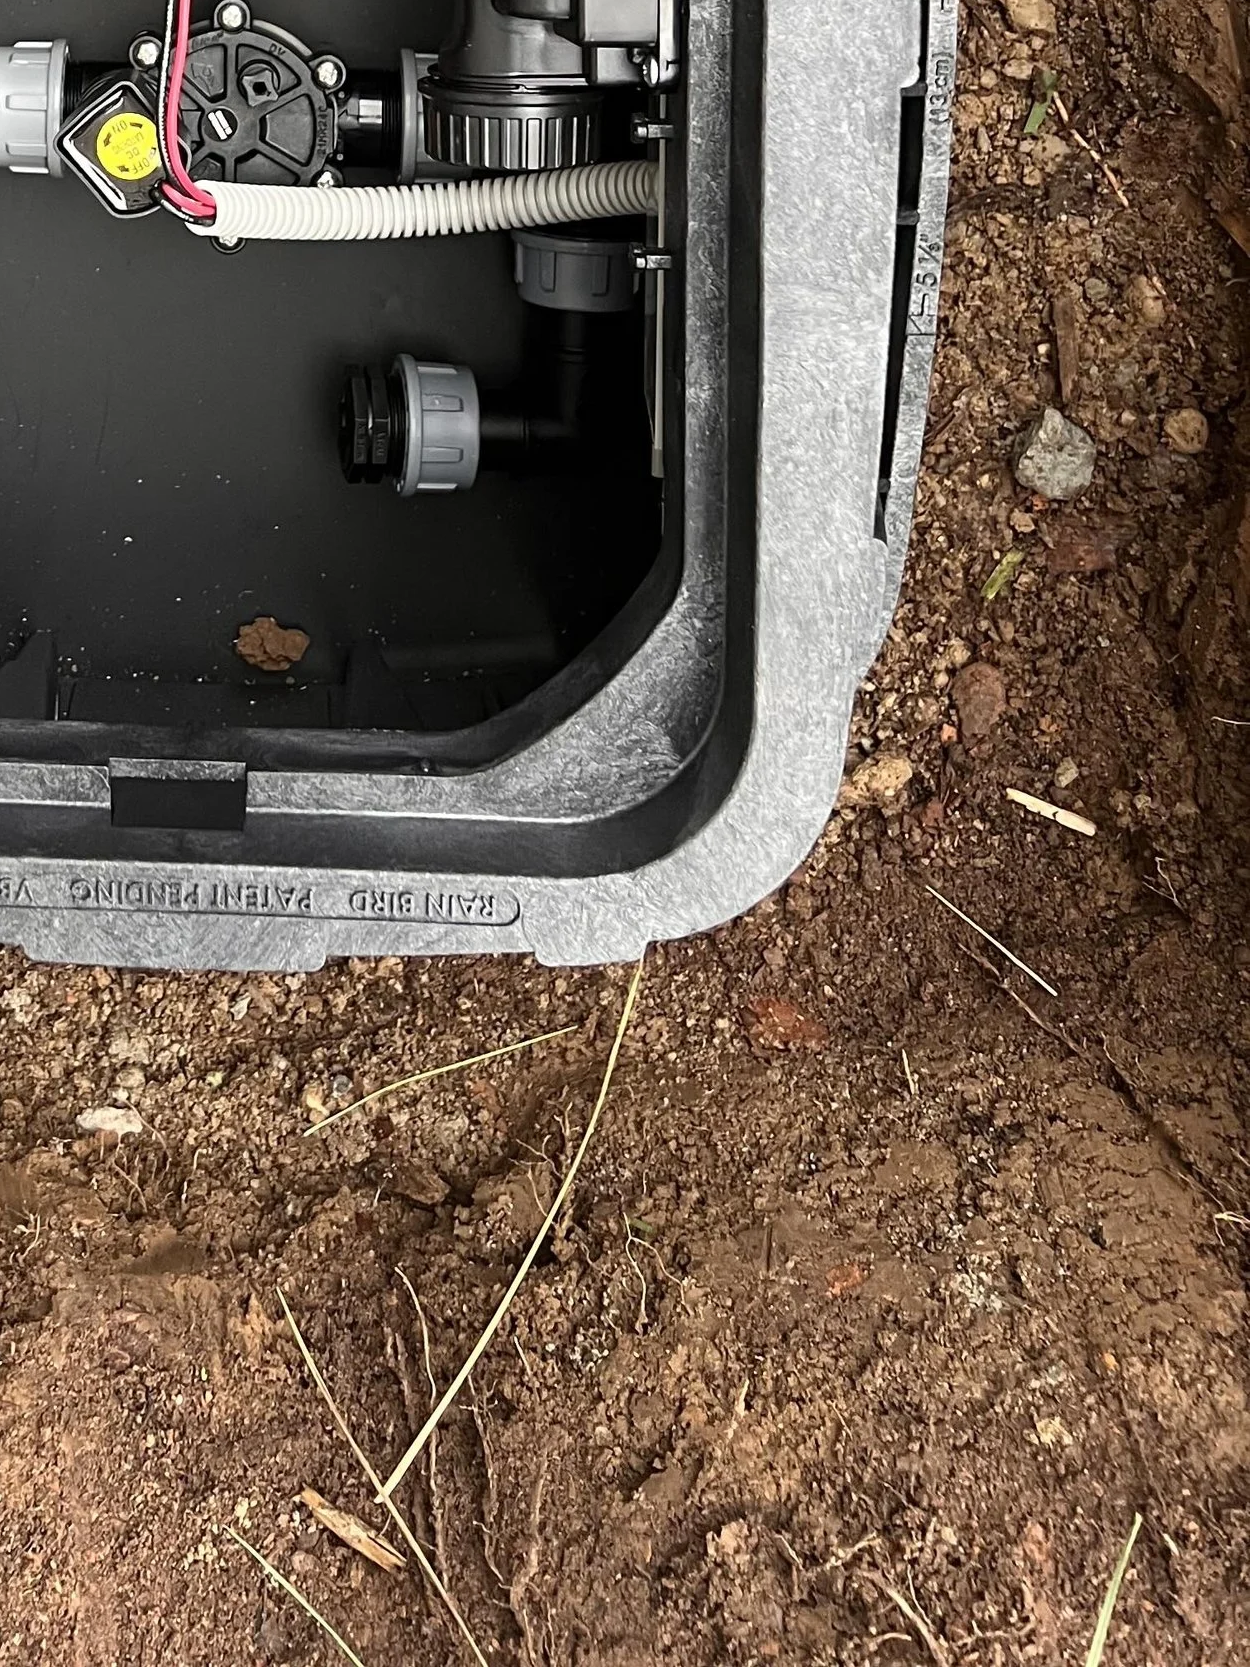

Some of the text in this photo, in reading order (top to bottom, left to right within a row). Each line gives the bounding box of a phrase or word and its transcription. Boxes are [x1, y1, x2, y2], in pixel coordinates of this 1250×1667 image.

[268, 42, 287, 57] DV
[931, 51, 953, 87] cm)
[928, 94, 950, 125] (13
[111, 119, 128, 135] ON
[125, 146, 140, 160] DC
[130, 157, 150, 175] OFF
[915, 272, 937, 287] 5
[69, 879, 201, 910] PENDING
[211, 884, 316, 914] PATENT
[347, 888, 415, 917] BIRD
[421, 891, 497, 921] RAIN
